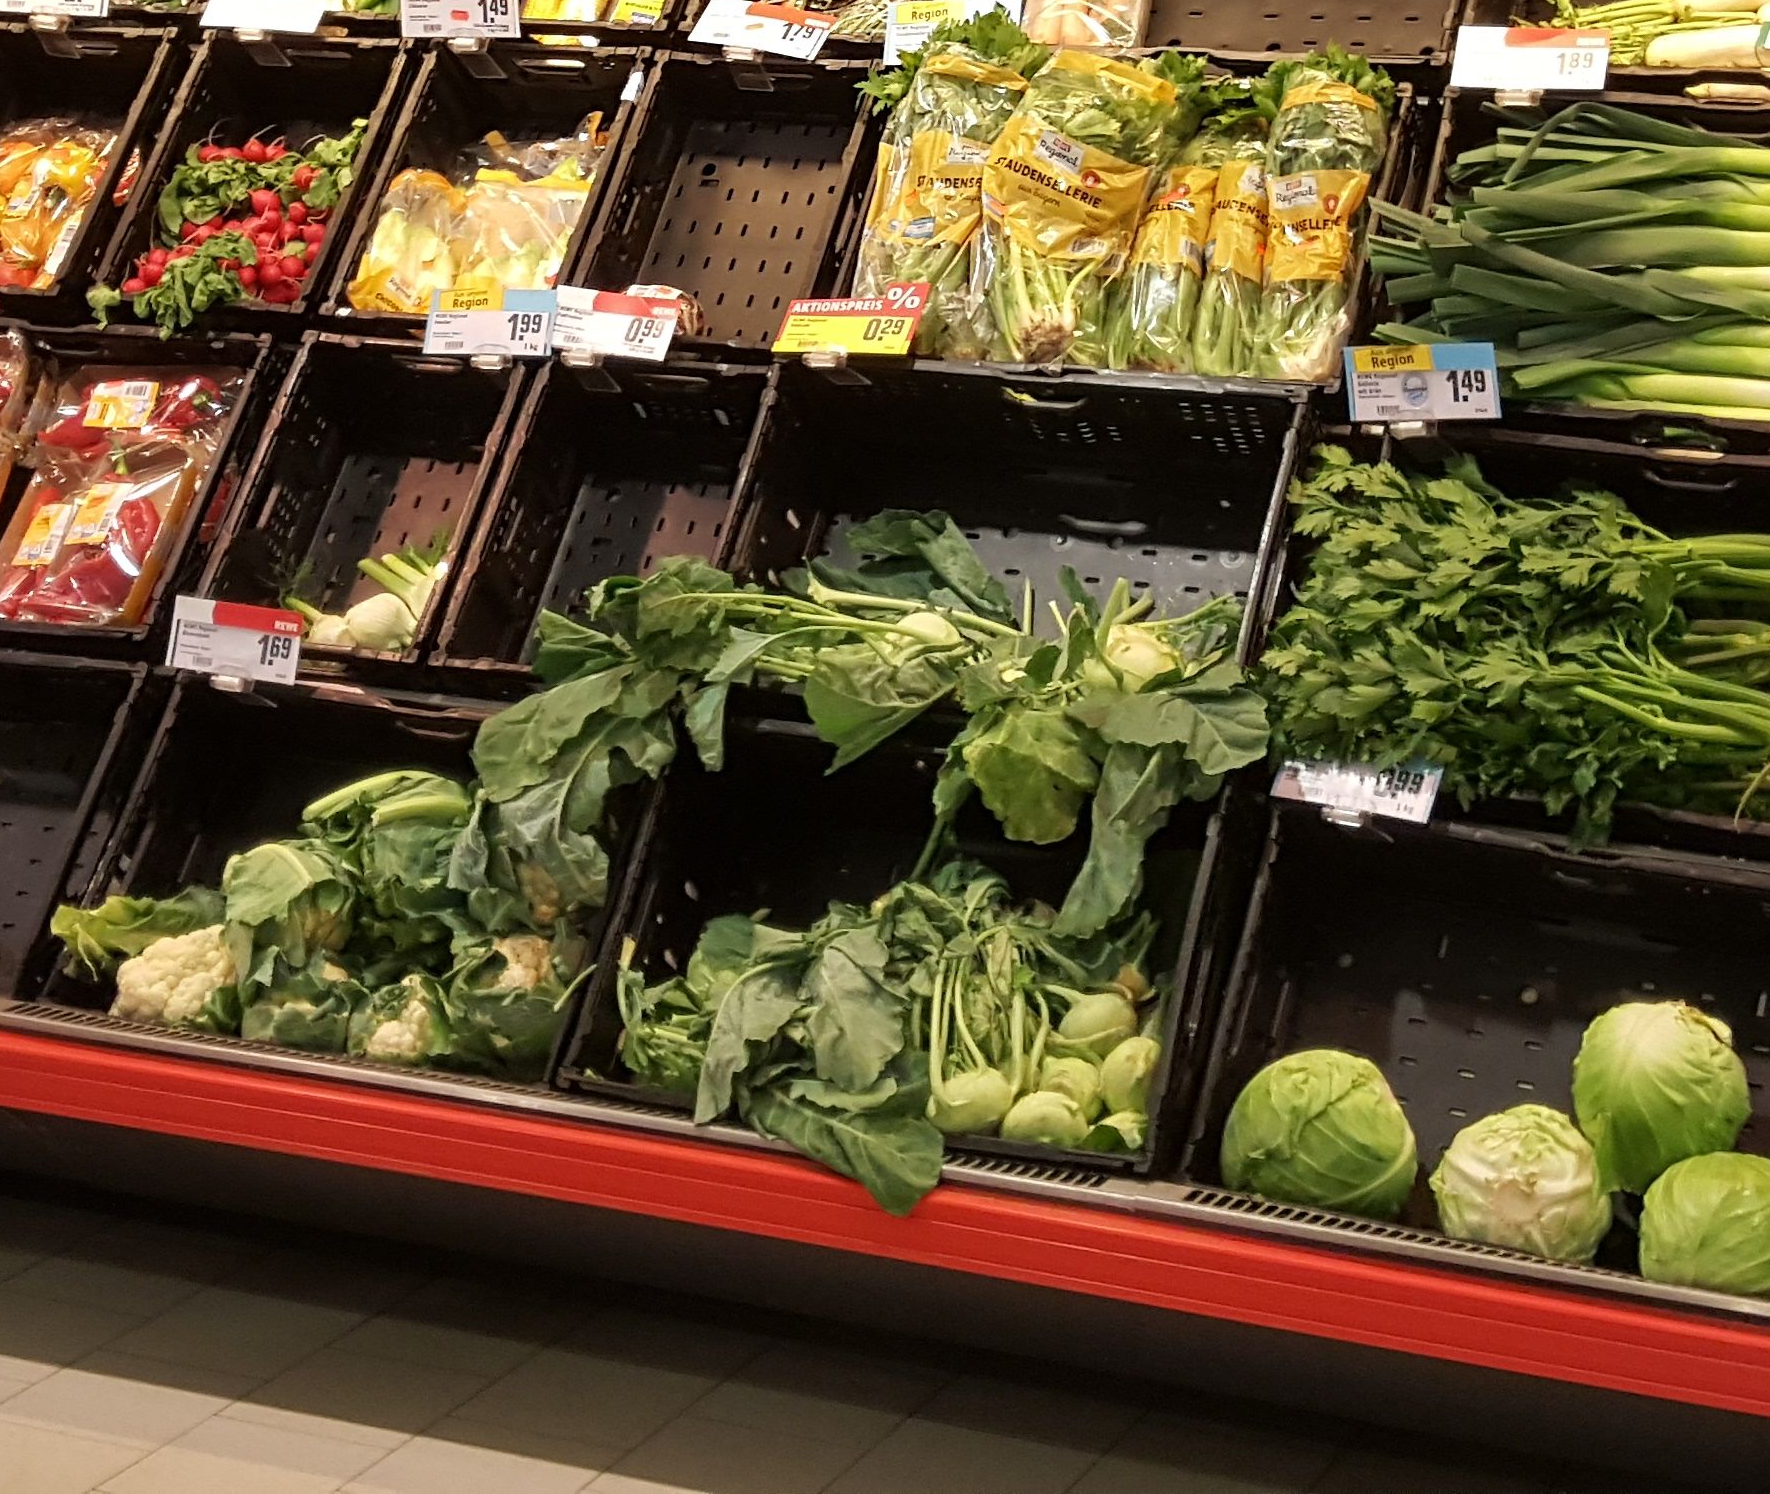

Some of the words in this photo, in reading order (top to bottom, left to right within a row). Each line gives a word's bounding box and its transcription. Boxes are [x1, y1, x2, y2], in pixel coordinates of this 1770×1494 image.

[911, 7, 949, 22] Region
[1556, 52, 1594, 76] 1.89
[996, 156, 1102, 209] STAUDENSELLERIE
[452, 296, 489, 310] Region
[792, 300, 884, 313] AKTIONSPREIS
[887, 286, 921, 310] %
[507, 313, 542, 341] 1.99
[624, 317, 664, 344] 0.99
[863, 318, 905, 341] 0.29
[1371, 355, 1415, 370] Region
[1446, 370, 1486, 403] 1.49
[274, 620, 299, 632] REWE
[257, 634, 292, 665] 1.69
